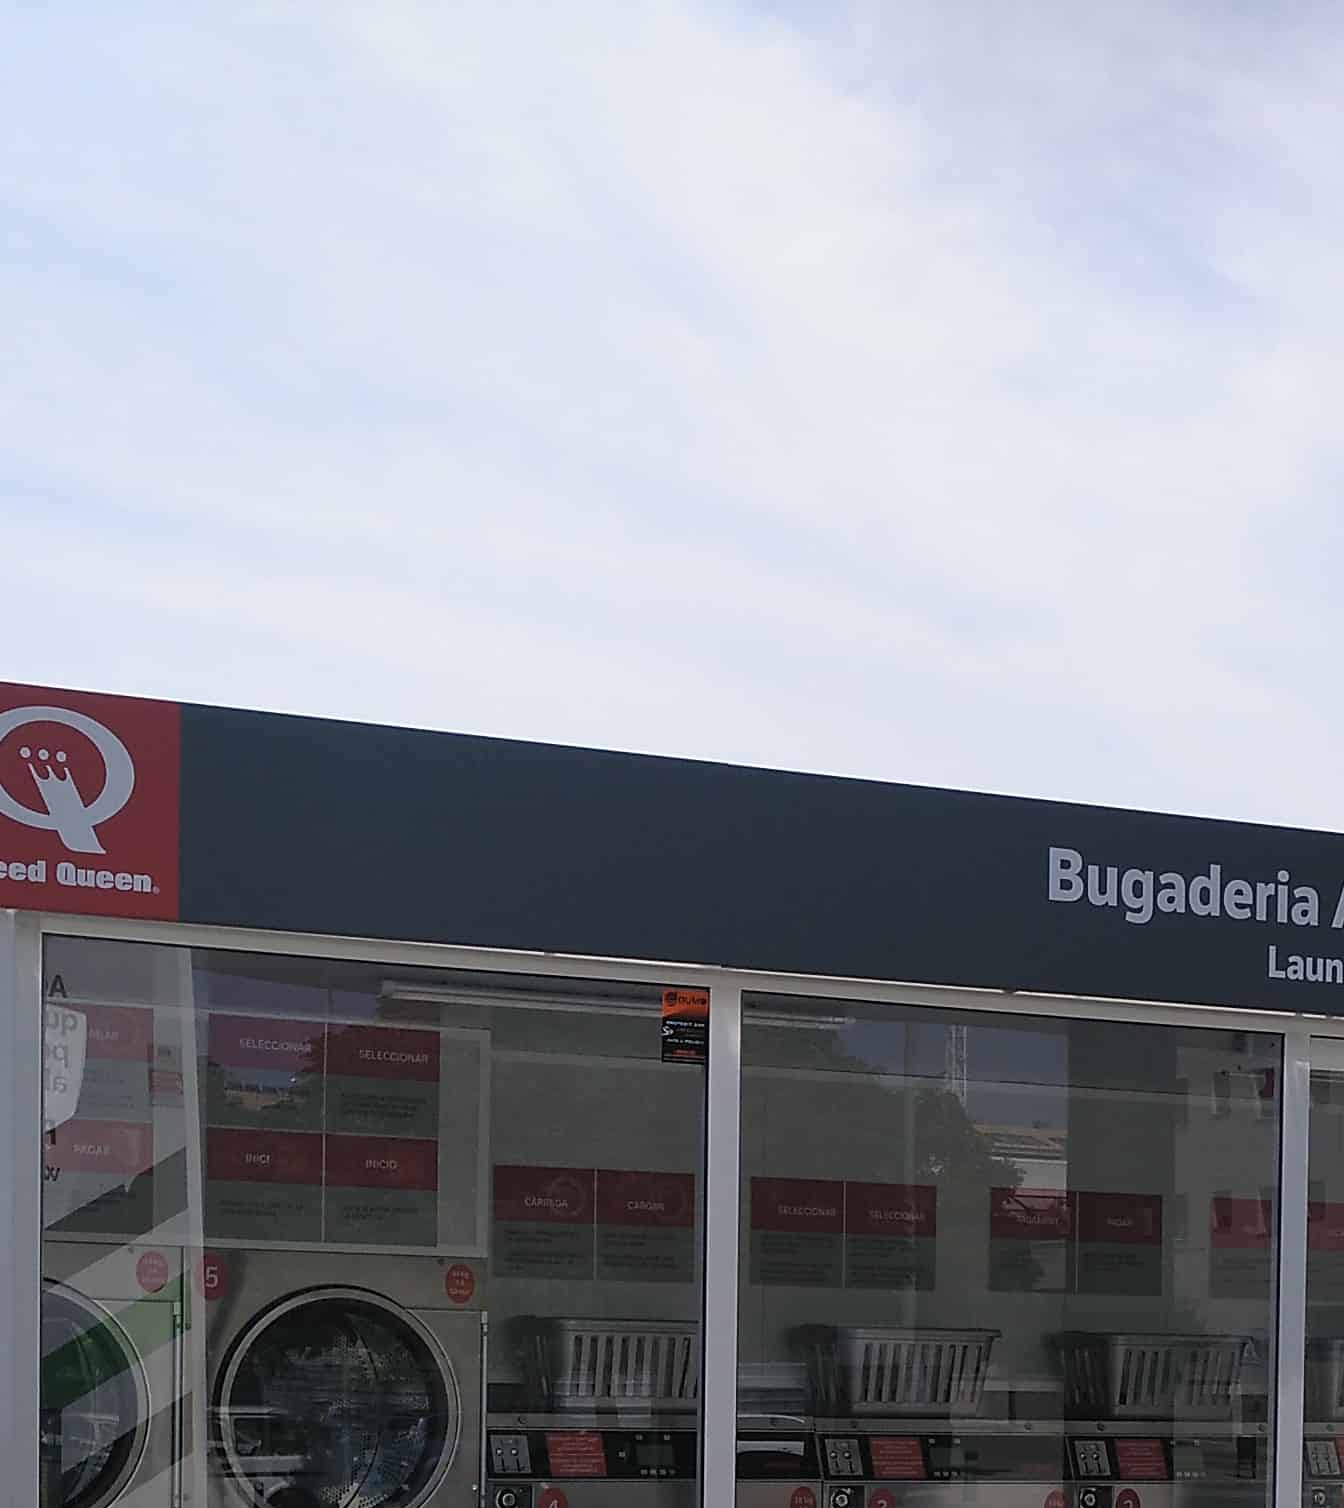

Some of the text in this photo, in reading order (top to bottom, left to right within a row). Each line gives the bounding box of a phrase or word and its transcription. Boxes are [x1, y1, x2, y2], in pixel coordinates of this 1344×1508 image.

[56, 859, 153, 893] Queen
[1046, 846, 1321, 927] Bugaderia
[205, 1265, 219, 1289] 5
